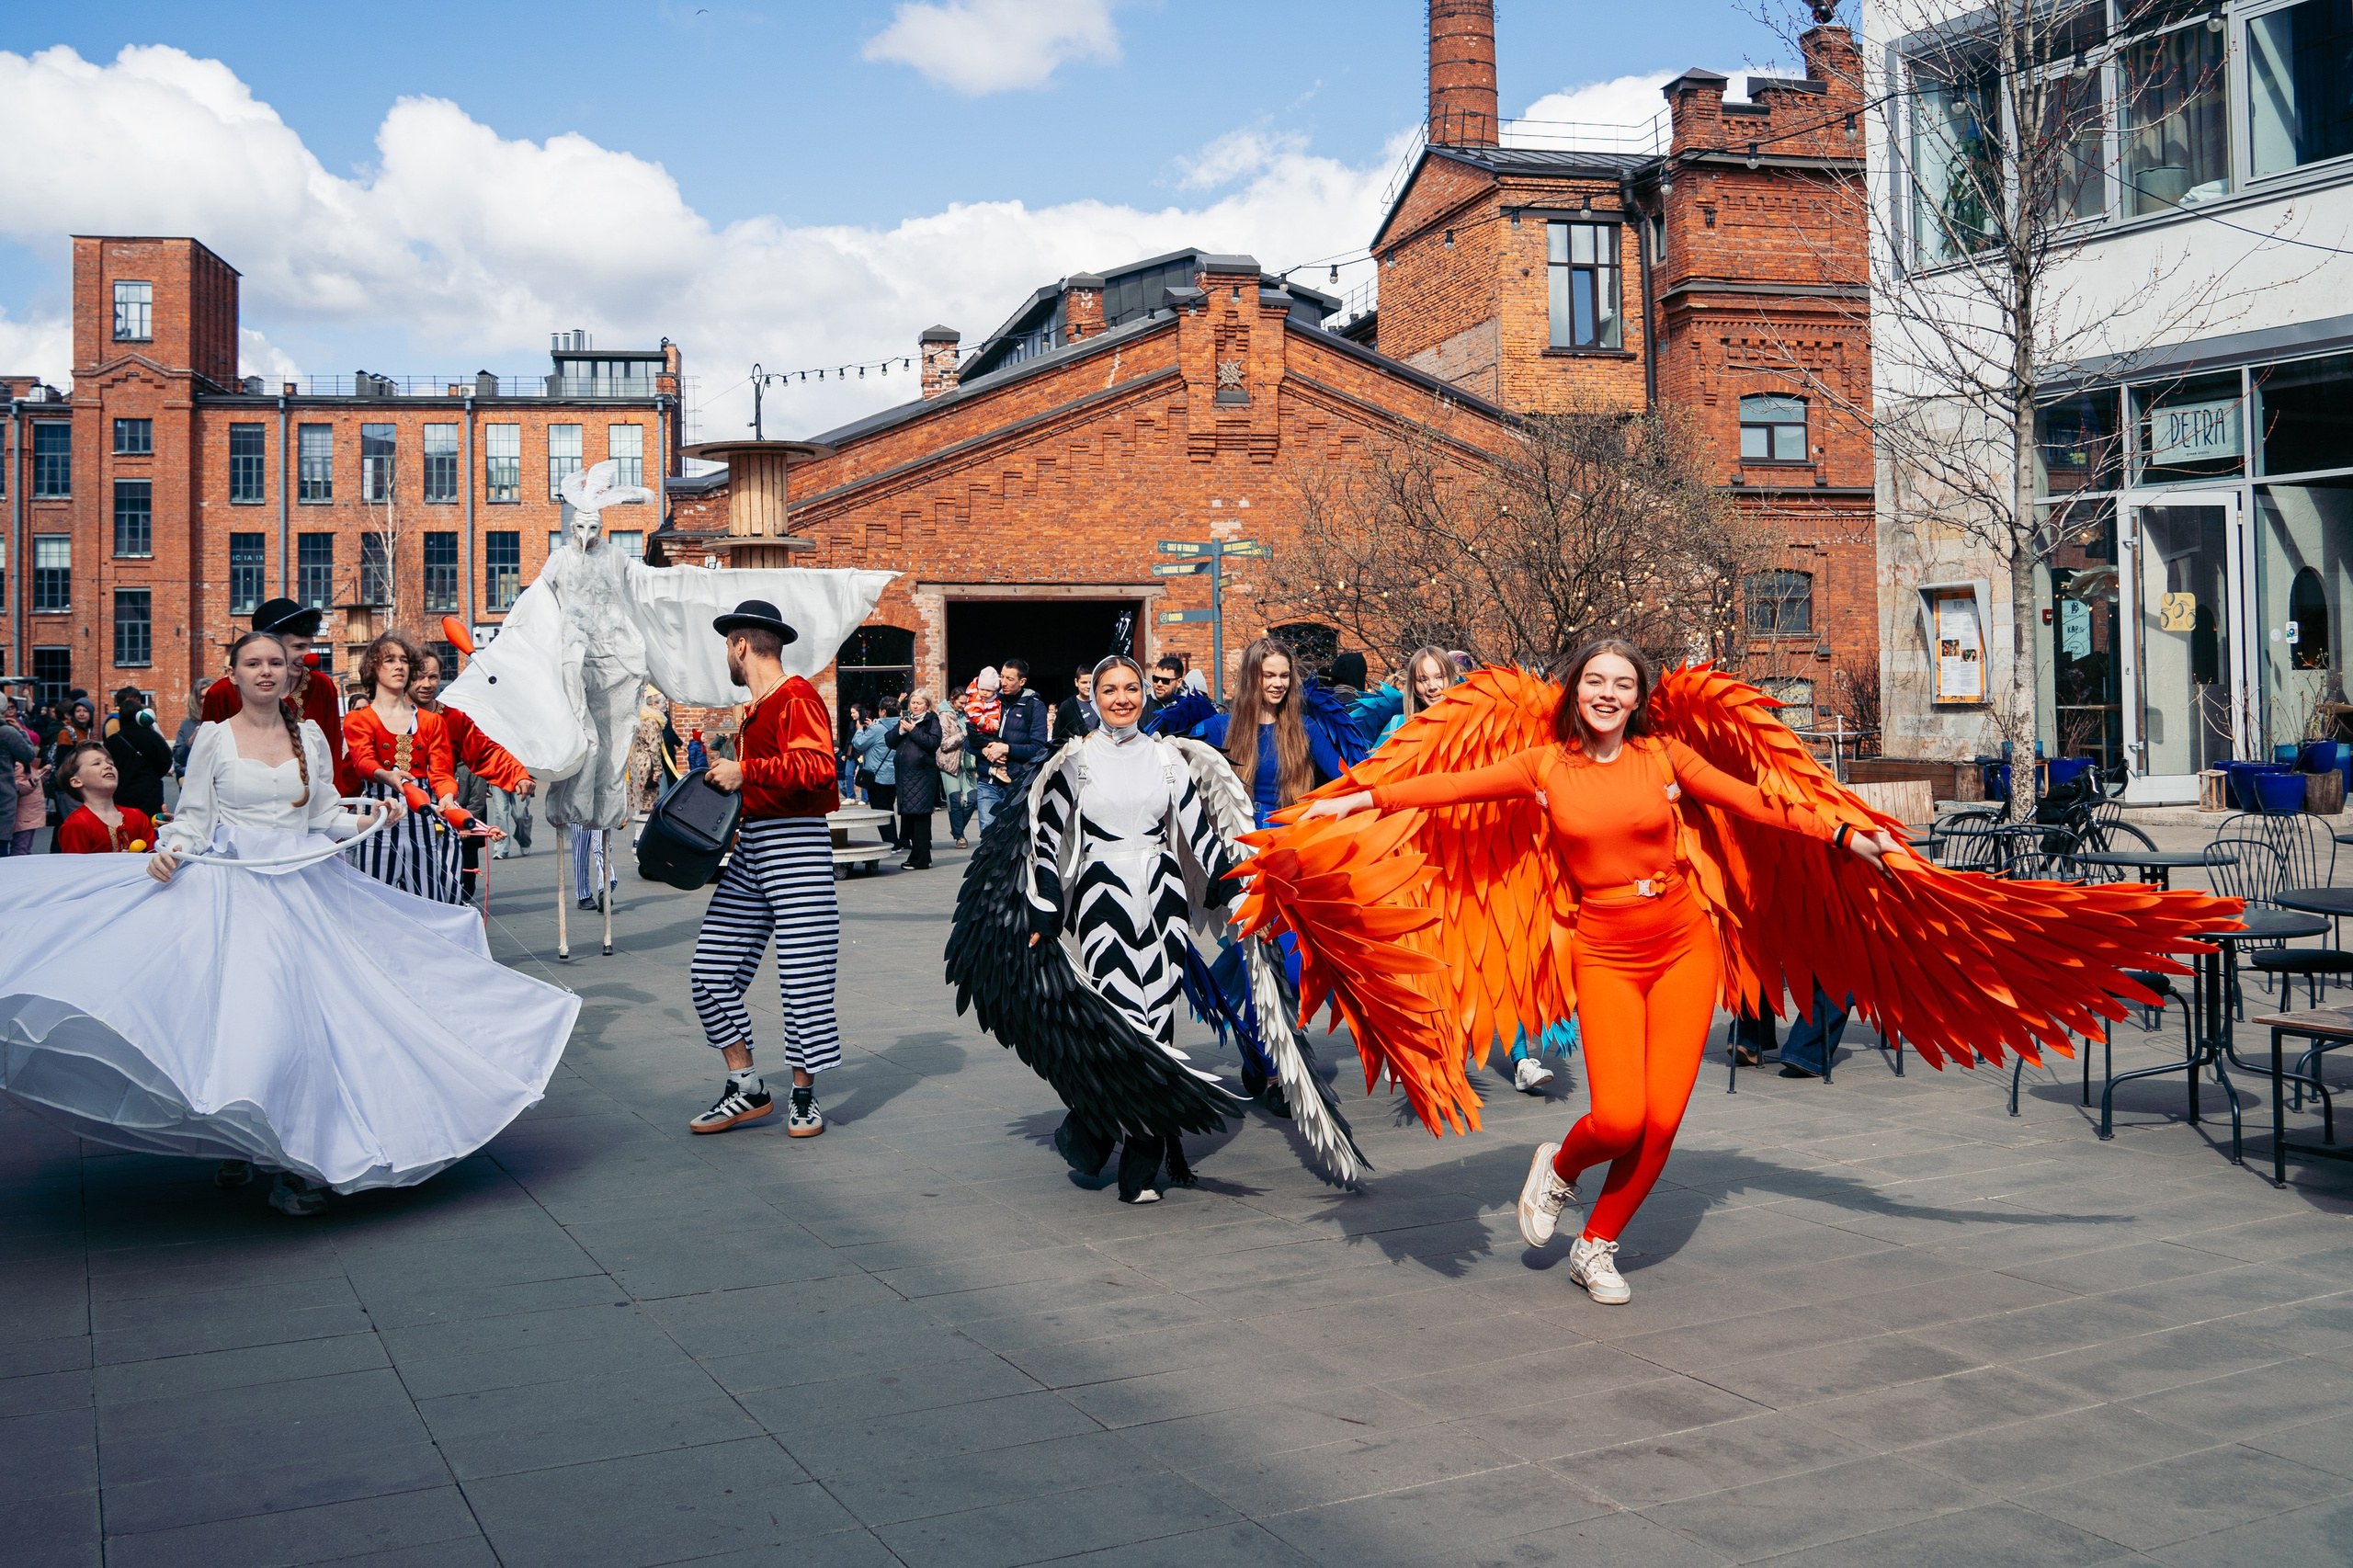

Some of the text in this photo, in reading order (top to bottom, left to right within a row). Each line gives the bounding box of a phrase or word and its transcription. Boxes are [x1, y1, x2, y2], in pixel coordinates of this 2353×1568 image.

[2170, 407, 2225, 449] PETRA
[1166, 543, 1199, 552] GULF OF FINLAND
